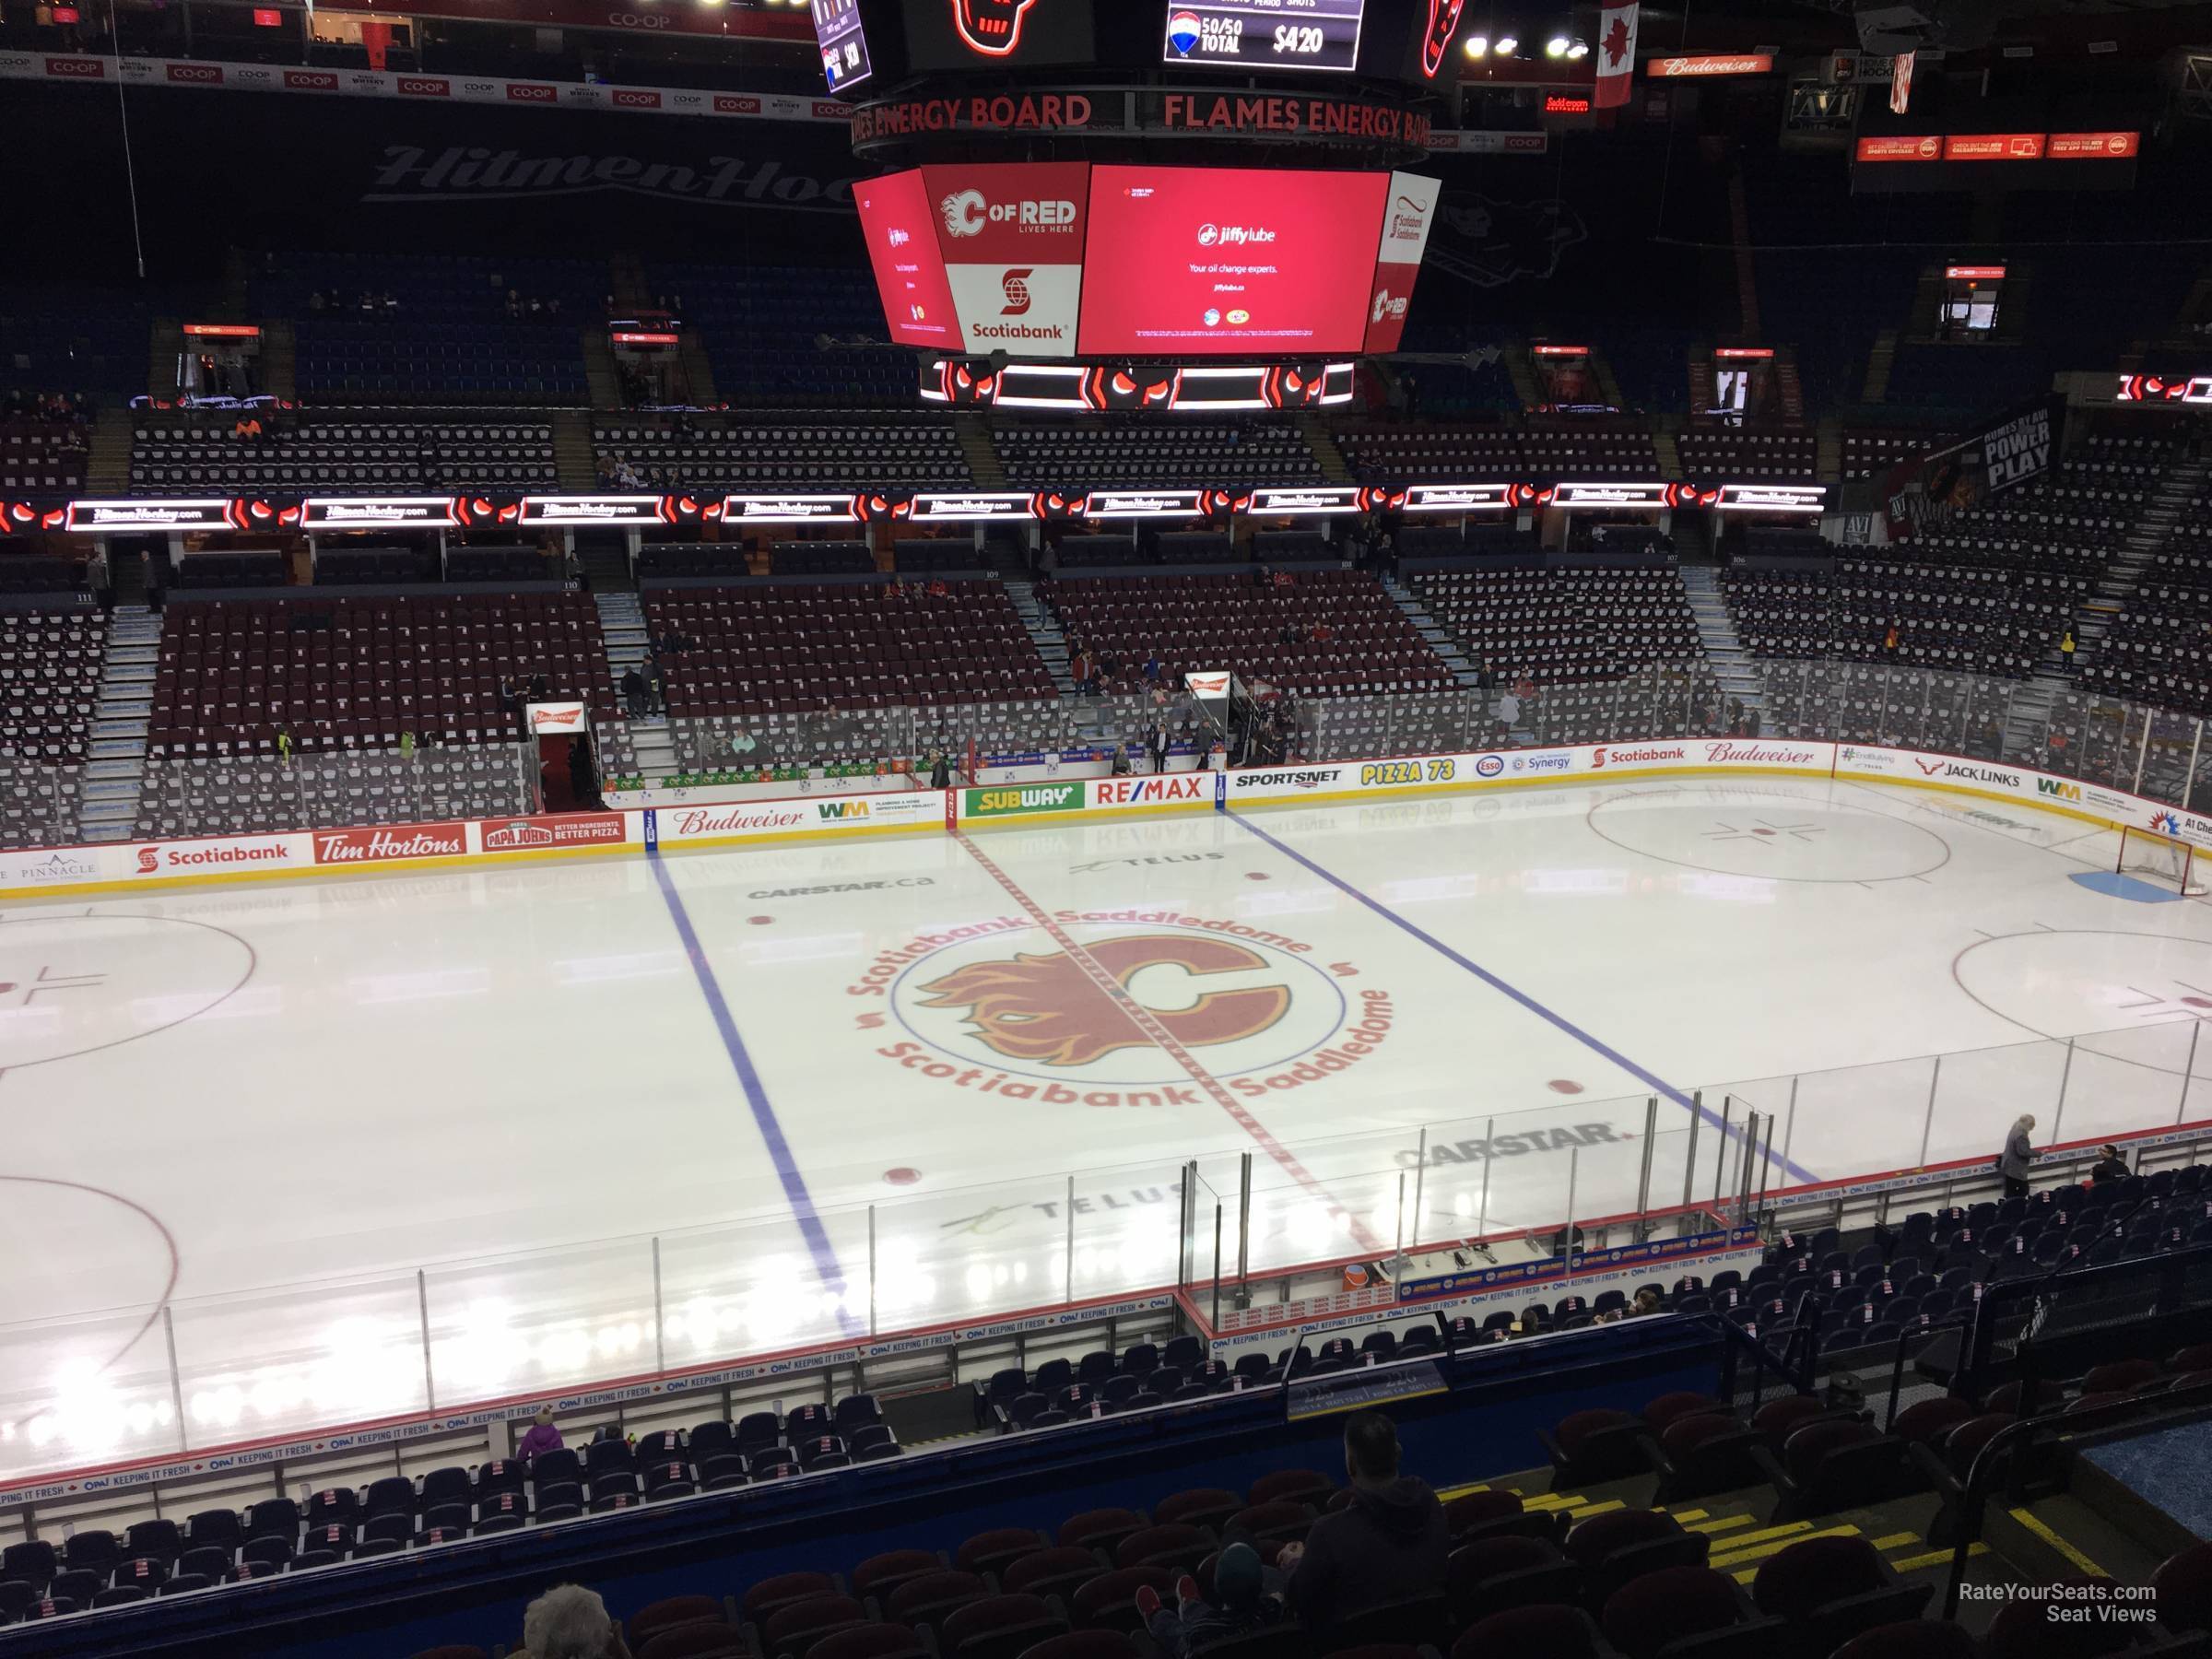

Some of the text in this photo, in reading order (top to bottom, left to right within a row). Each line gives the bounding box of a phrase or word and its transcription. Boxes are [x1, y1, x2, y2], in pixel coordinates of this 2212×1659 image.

[609, 13, 670, 29] CO-OP
[1202, 18, 1242, 35] 50/50
[1202, 35, 1240, 53] TOTAL
[1274, 25, 1323, 53] $420
[53, 62, 97, 73] CO-OP
[173, 68, 216, 79] CO-OP
[1664, 58, 1758, 75] Budweiser
[290, 76, 332, 85] CO-OP
[404, 81, 443, 91] CO-OP
[513, 88, 551, 97] CO-OP
[618, 94, 655, 104] CO-OP
[719, 100, 755, 110] CO-OP
[876, 95, 1091, 135] ENERGY BOARD
[1165, 95, 1399, 139] FLAMES ENERGY
[373, 145, 708, 188] Hitmen
[989, 204, 1017, 221] OF
[1019, 200, 1076, 224] RED
[1189, 264, 1206, 274] Your
[1207, 264, 1218, 274] oil
[1219, 265, 1246, 276] change
[973, 324, 1063, 339] Scotiabank
[1985, 421, 2050, 465] POWER
[1989, 443, 2051, 487] PLAY
[1846, 516, 1869, 534] AVI
[1611, 747, 1684, 763] Scotiabank
[1705, 741, 1814, 764] Budweiser
[1361, 759, 1455, 785] PIZZA 73
[1529, 758, 1570, 770] Synergy
[1236, 770, 1341, 787] SPORTSNET
[1944, 763, 2020, 787] JACK LINK'S
[1097, 777, 1202, 805] RE/MAX
[2038, 777, 2080, 800] WM
[978, 786, 1074, 811] SUBWAY
[818, 801, 869, 818] WM
[674, 809, 804, 835] Budweiser
[2185, 818, 2194, 829] A1
[488, 830, 515, 846] PAPA
[555, 828, 620, 840] BETTER PIZZA.
[169, 844, 288, 865] Scotiabank
[319, 831, 460, 861] Tim Hortons
[1124, 852, 1226, 867] TELUS
[22, 865, 96, 878] PINNACLE
[1053, 909, 1312, 955] Saddledome
[847, 916, 1029, 996] Scotiabank
[1230, 988, 1393, 1097] Saddledome
[877, 1041, 1202, 1107] Scotiabank
[1080, 1309, 1106, 1320] KEEPING
[1108, 1307, 1114, 1315] IT
[1116, 1303, 1135, 1313] FRESH
[988, 1324, 1015, 1335] KEEPING
[1025, 1318, 1045, 1329] FRESH
[893, 1340, 921, 1352] KEEPING
[922, 1338, 929, 1347] IT
[931, 1335, 952, 1346] FRESH
[794, 1357, 823, 1370] KEEPING
[825, 1355, 831, 1363] IT
[833, 1350, 855, 1361] FRESH
[691, 1374, 722, 1387] KEEPING
[723, 1372, 730, 1381] IT
[732, 1368, 755, 1380] FRESH
[584, 1392, 616, 1406] KEEPING
[617, 1390, 624, 1398] IT
[627, 1386, 650, 1398] FRESH
[473, 1411, 505, 1424] KEEPING
[507, 1409, 514, 1418] IT
[516, 1406, 541, 1417] FRESH
[358, 1430, 392, 1444] KEEPING
[394, 1429, 402, 1438] IT
[404, 1424, 429, 1437] FRESH
[238, 1452, 274, 1465] KEEPING
[276, 1449, 284, 1458] IT
[285, 1444, 312, 1456] FRESH
[113, 1473, 150, 1487] KEEPING
[151, 1471, 160, 1481] IT
[162, 1465, 190, 1477] FRESH
[24, 1486, 64, 1500] IT FRESH
